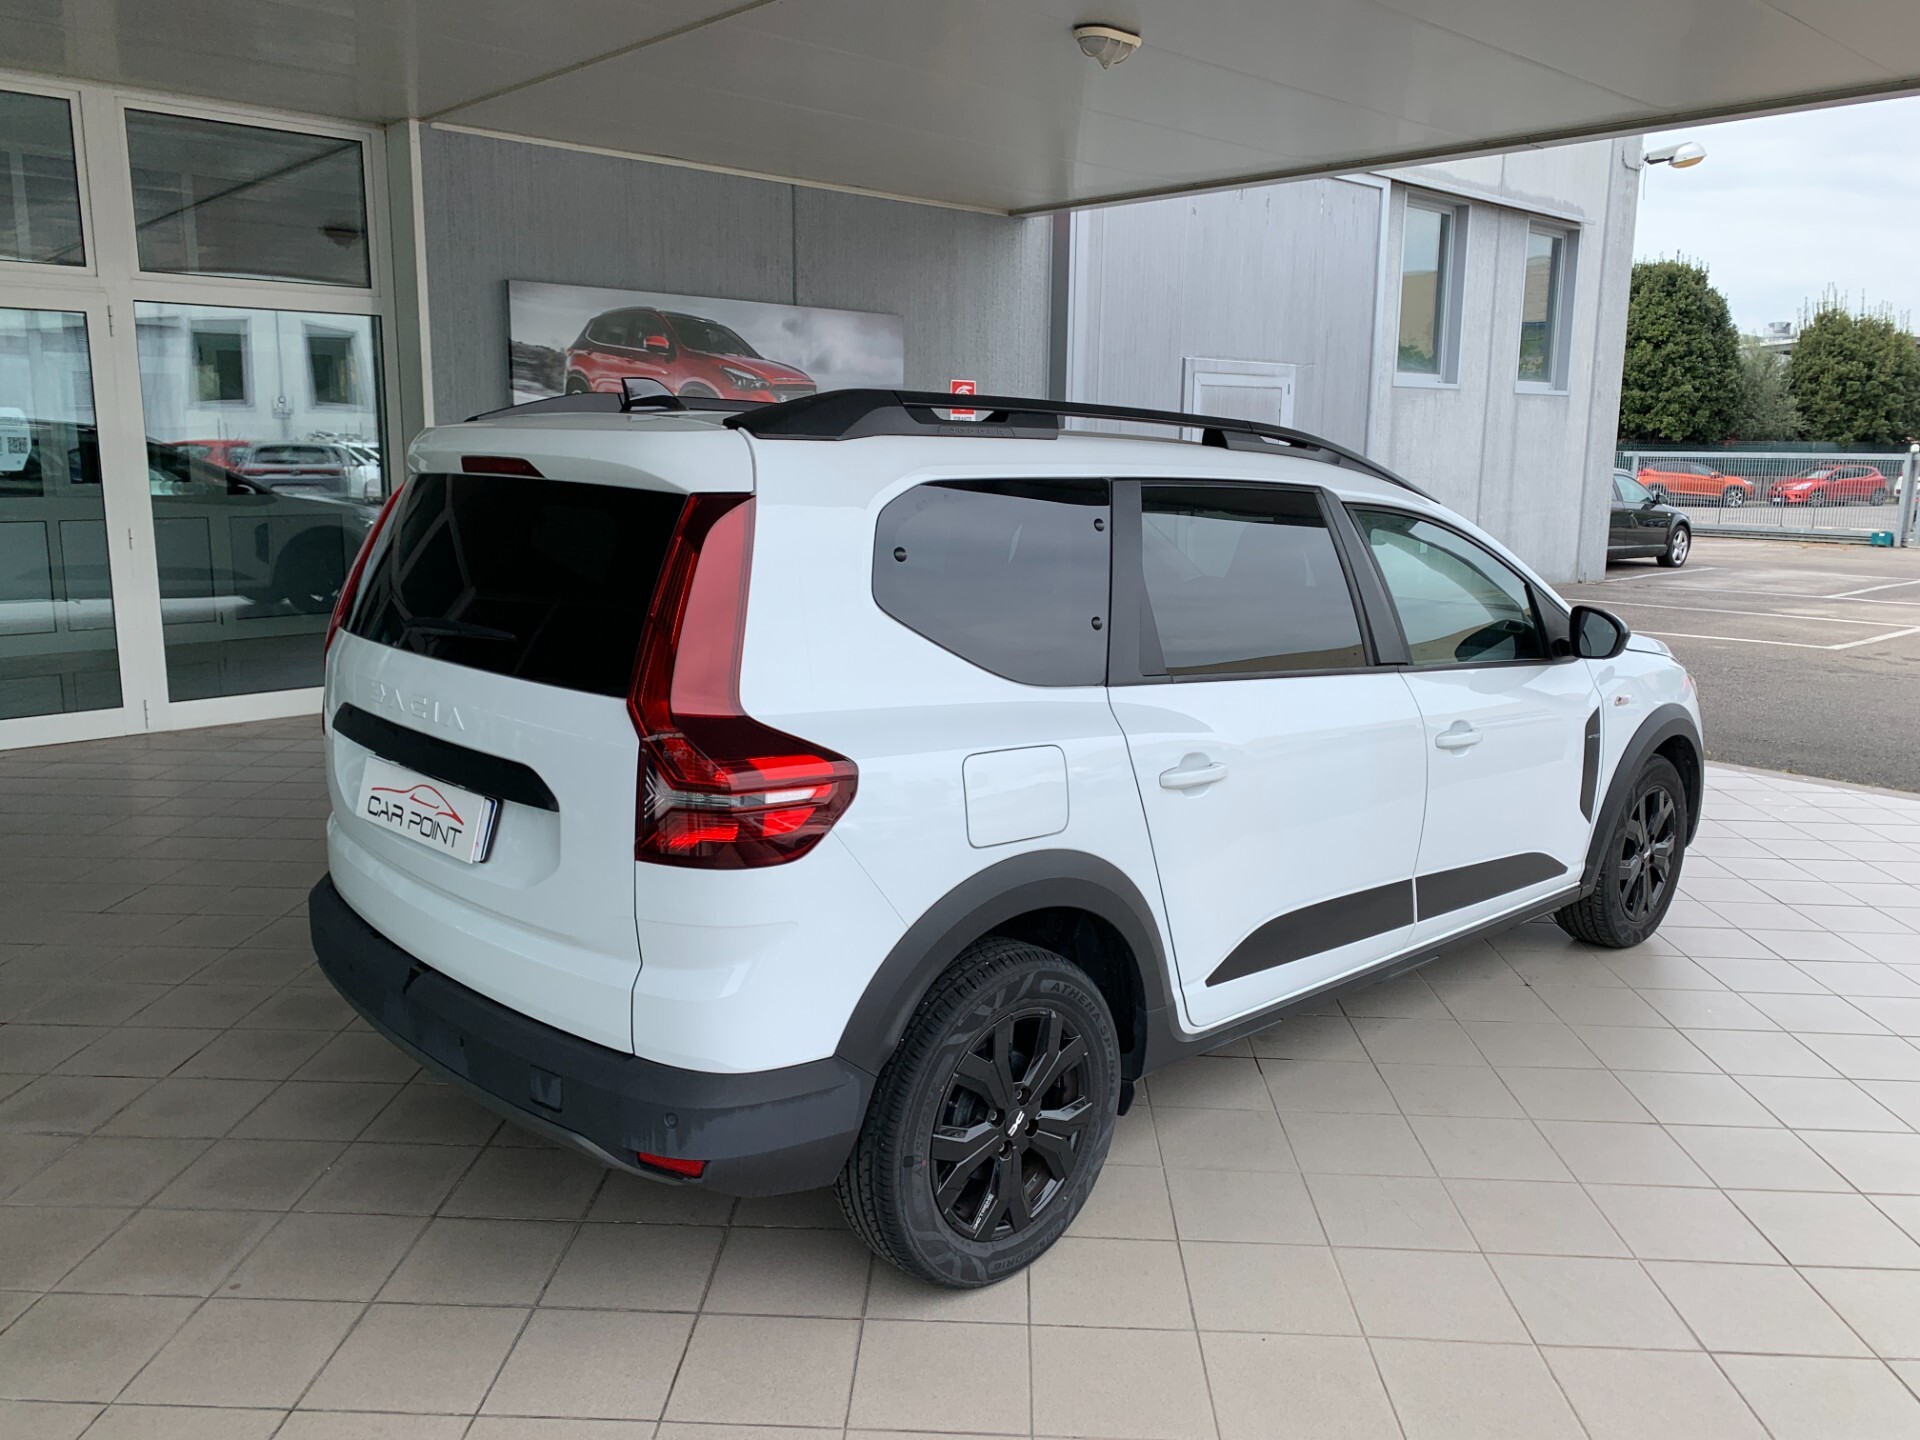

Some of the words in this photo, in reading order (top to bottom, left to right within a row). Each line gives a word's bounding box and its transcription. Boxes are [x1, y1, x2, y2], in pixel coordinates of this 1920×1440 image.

[367, 795, 404, 827] CAR
[407, 811, 462, 848] POINT
[1051, 982, 1102, 1023] ATHENA
